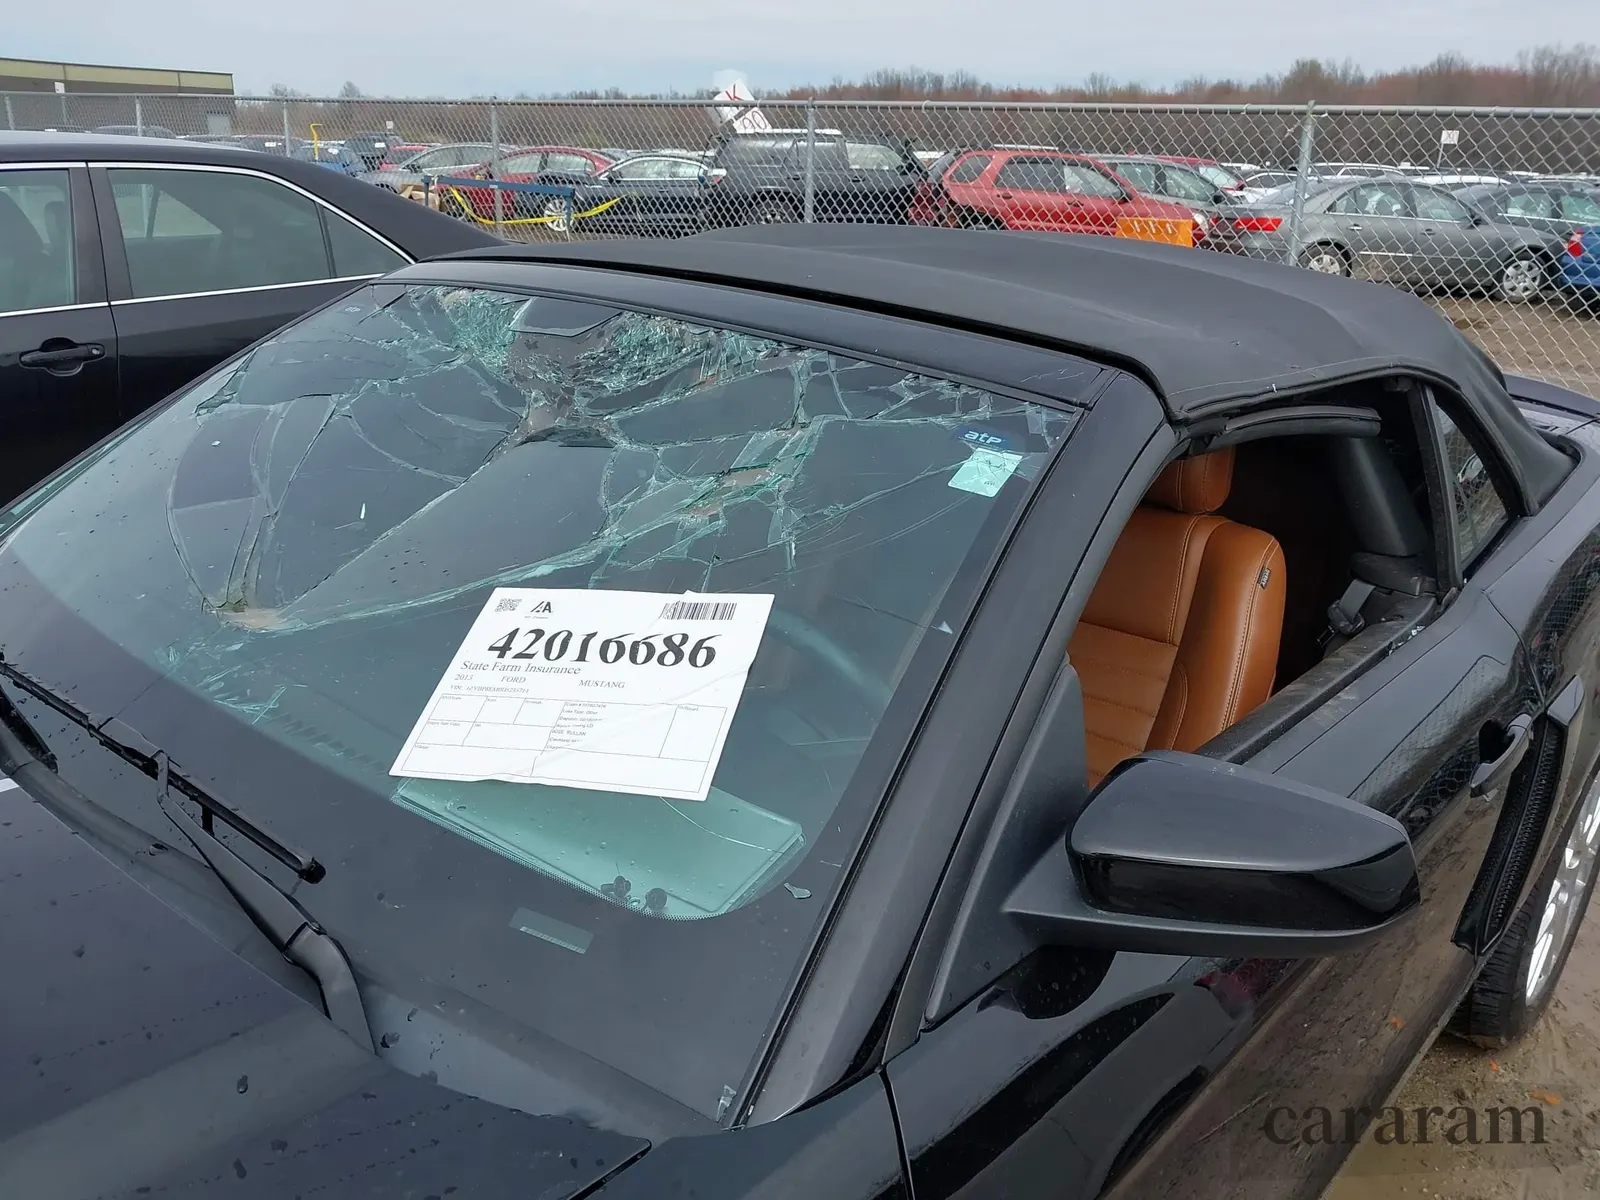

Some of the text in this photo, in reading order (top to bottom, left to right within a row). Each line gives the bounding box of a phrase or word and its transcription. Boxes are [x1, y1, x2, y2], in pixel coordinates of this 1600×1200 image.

[487, 627, 723, 669] 42016686
[460, 660, 582, 676] State Farm Insurance
[500, 675, 527, 684] FORD
[578, 679, 626, 689] MUSTANG
